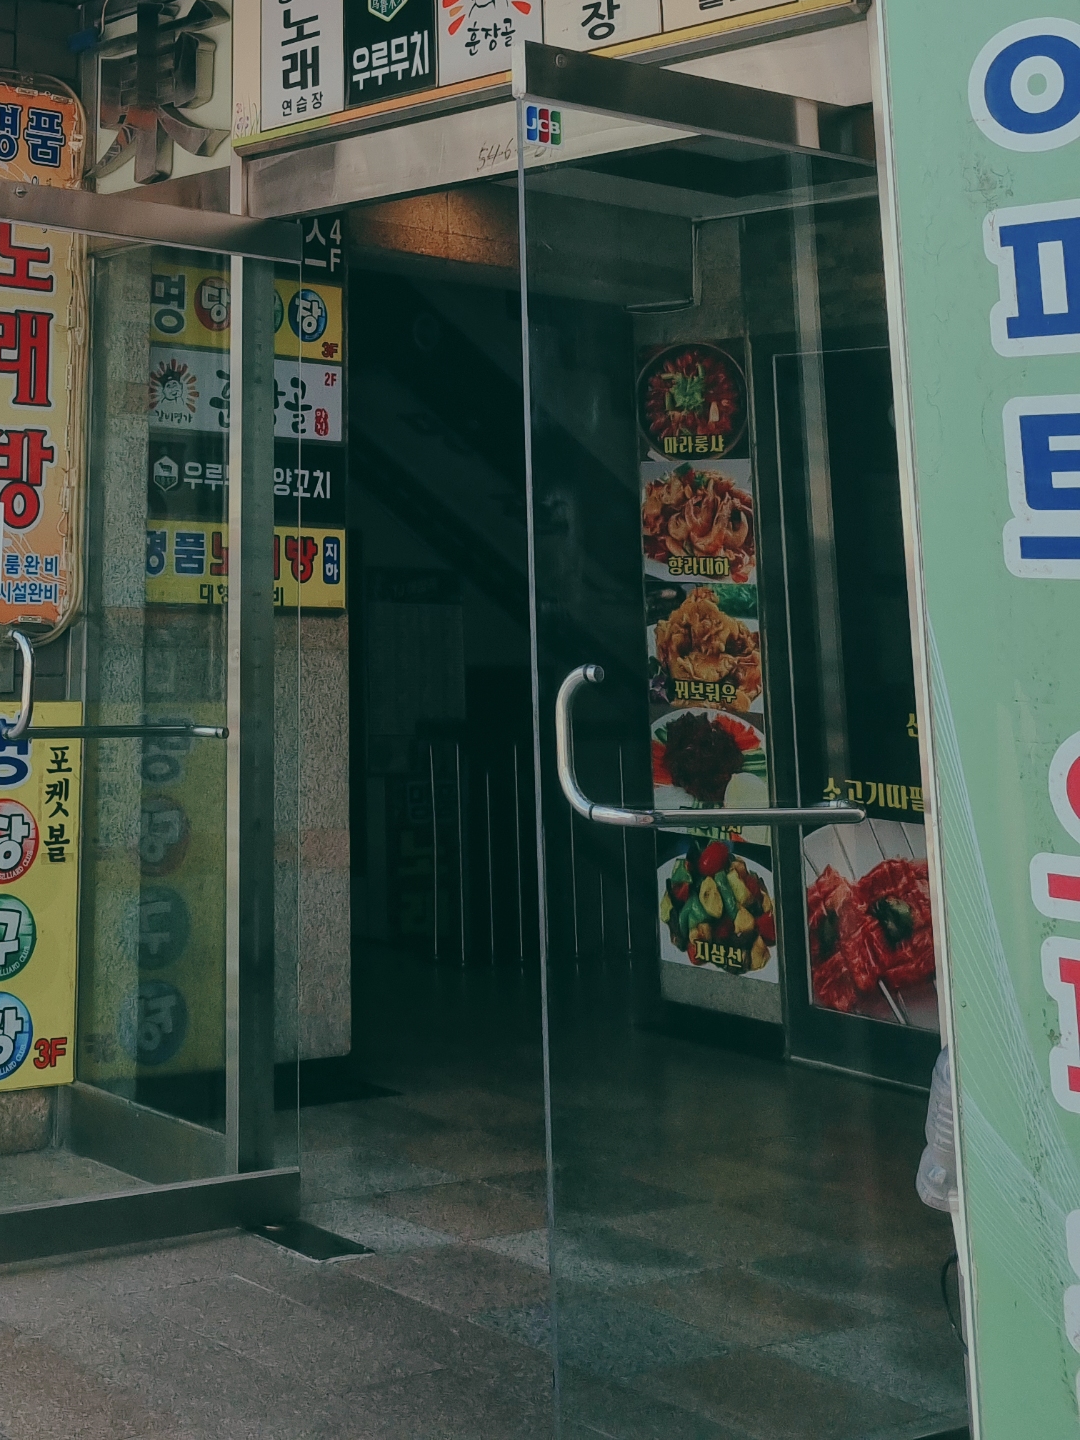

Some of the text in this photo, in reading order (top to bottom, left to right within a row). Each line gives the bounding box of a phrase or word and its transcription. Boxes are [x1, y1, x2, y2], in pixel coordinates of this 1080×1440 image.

[281, 5, 321, 91] 노래
[464, 16, 514, 56] 훈장골
[352, 31, 430, 91] 우루무치
[281, 91, 324, 117] 연습장
[151, 274, 323, 344] 명당장
[321, 342, 338, 358] 3F
[324, 372, 337, 388] 2F
[664, 433, 725, 455] 마라룽샤
[668, 555, 730, 577] 향라대하
[674, 680, 737, 703] 꿔보뤄우
[43, 746, 72, 864] 포켓볼
[694, 939, 745, 969] 지삼선
[33, 1038, 67, 1070] 3F
